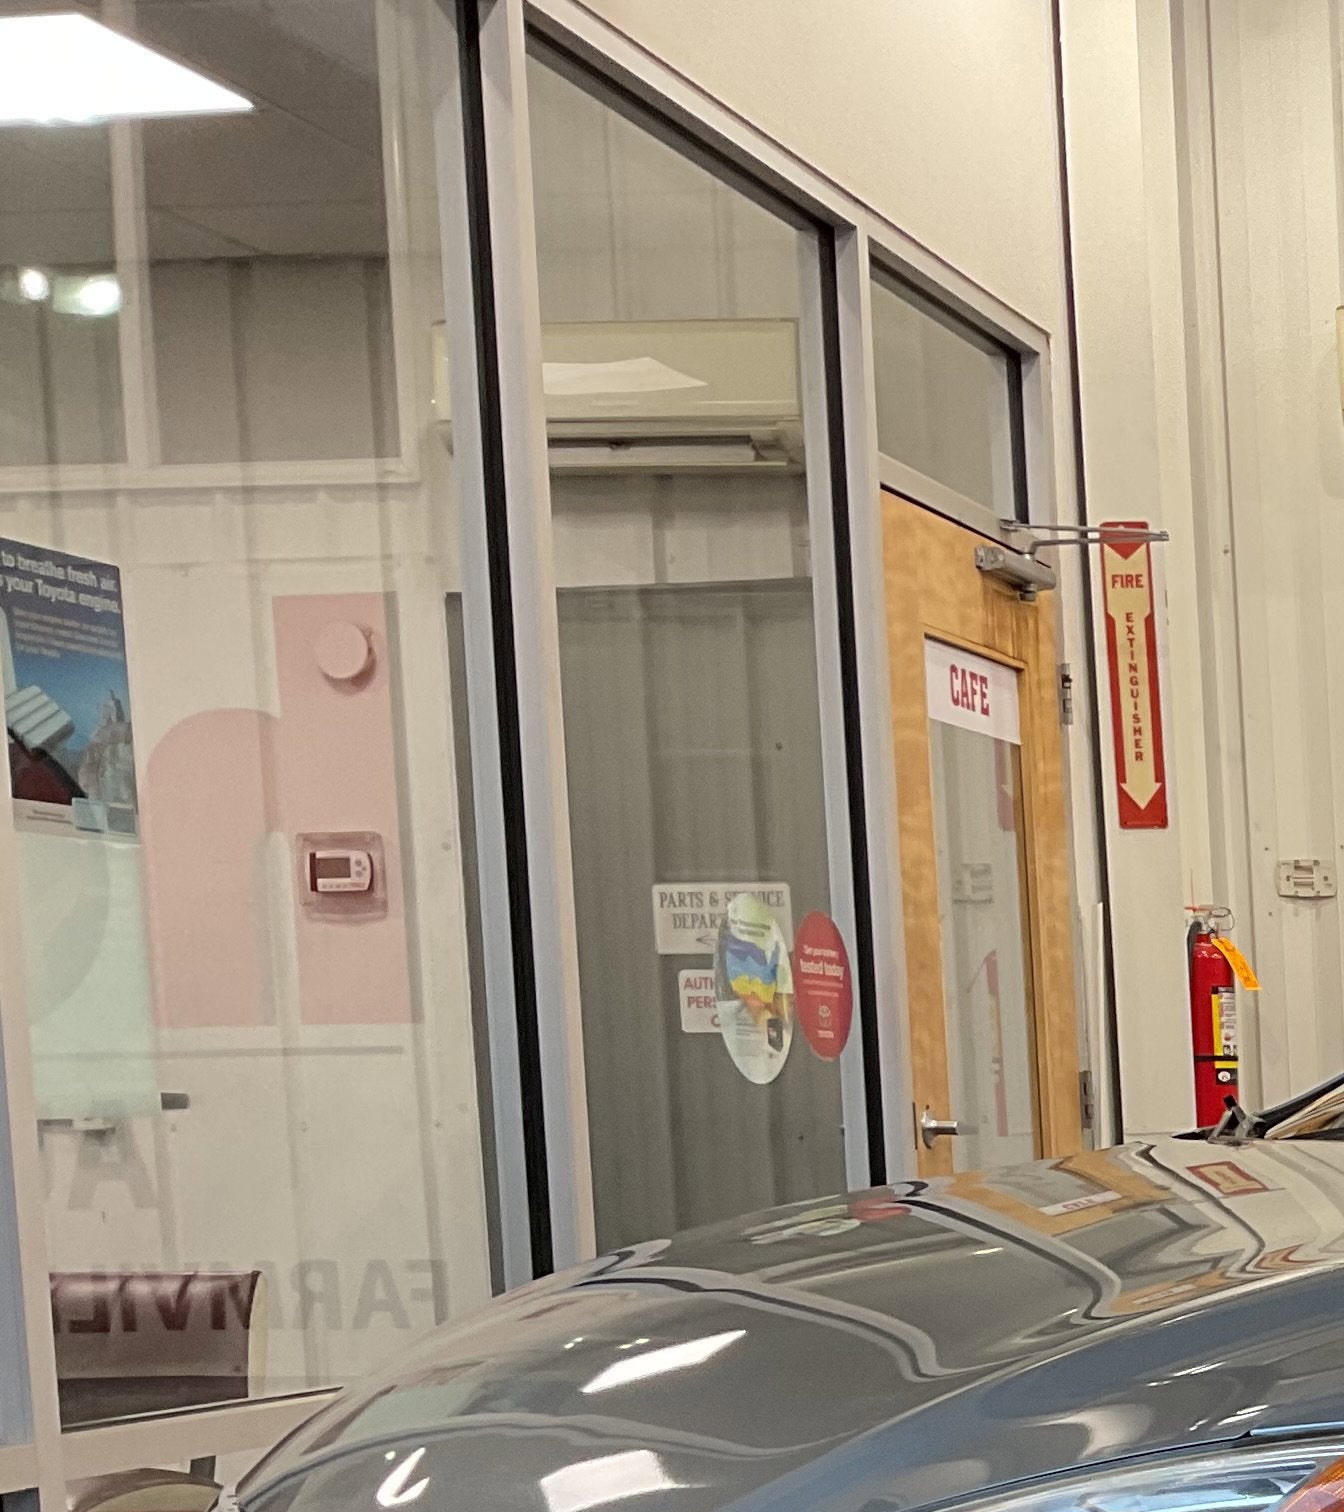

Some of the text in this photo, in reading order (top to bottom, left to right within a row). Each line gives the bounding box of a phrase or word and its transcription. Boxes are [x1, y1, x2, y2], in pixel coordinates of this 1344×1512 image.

[35, 578, 77, 602] Toyota
[1111, 573, 1144, 589] FIRE
[949, 663, 990, 718] CAFE
[1125, 612, 1144, 762] EXTINGUISHER
[658, 890, 785, 909] PARTS & SICE
